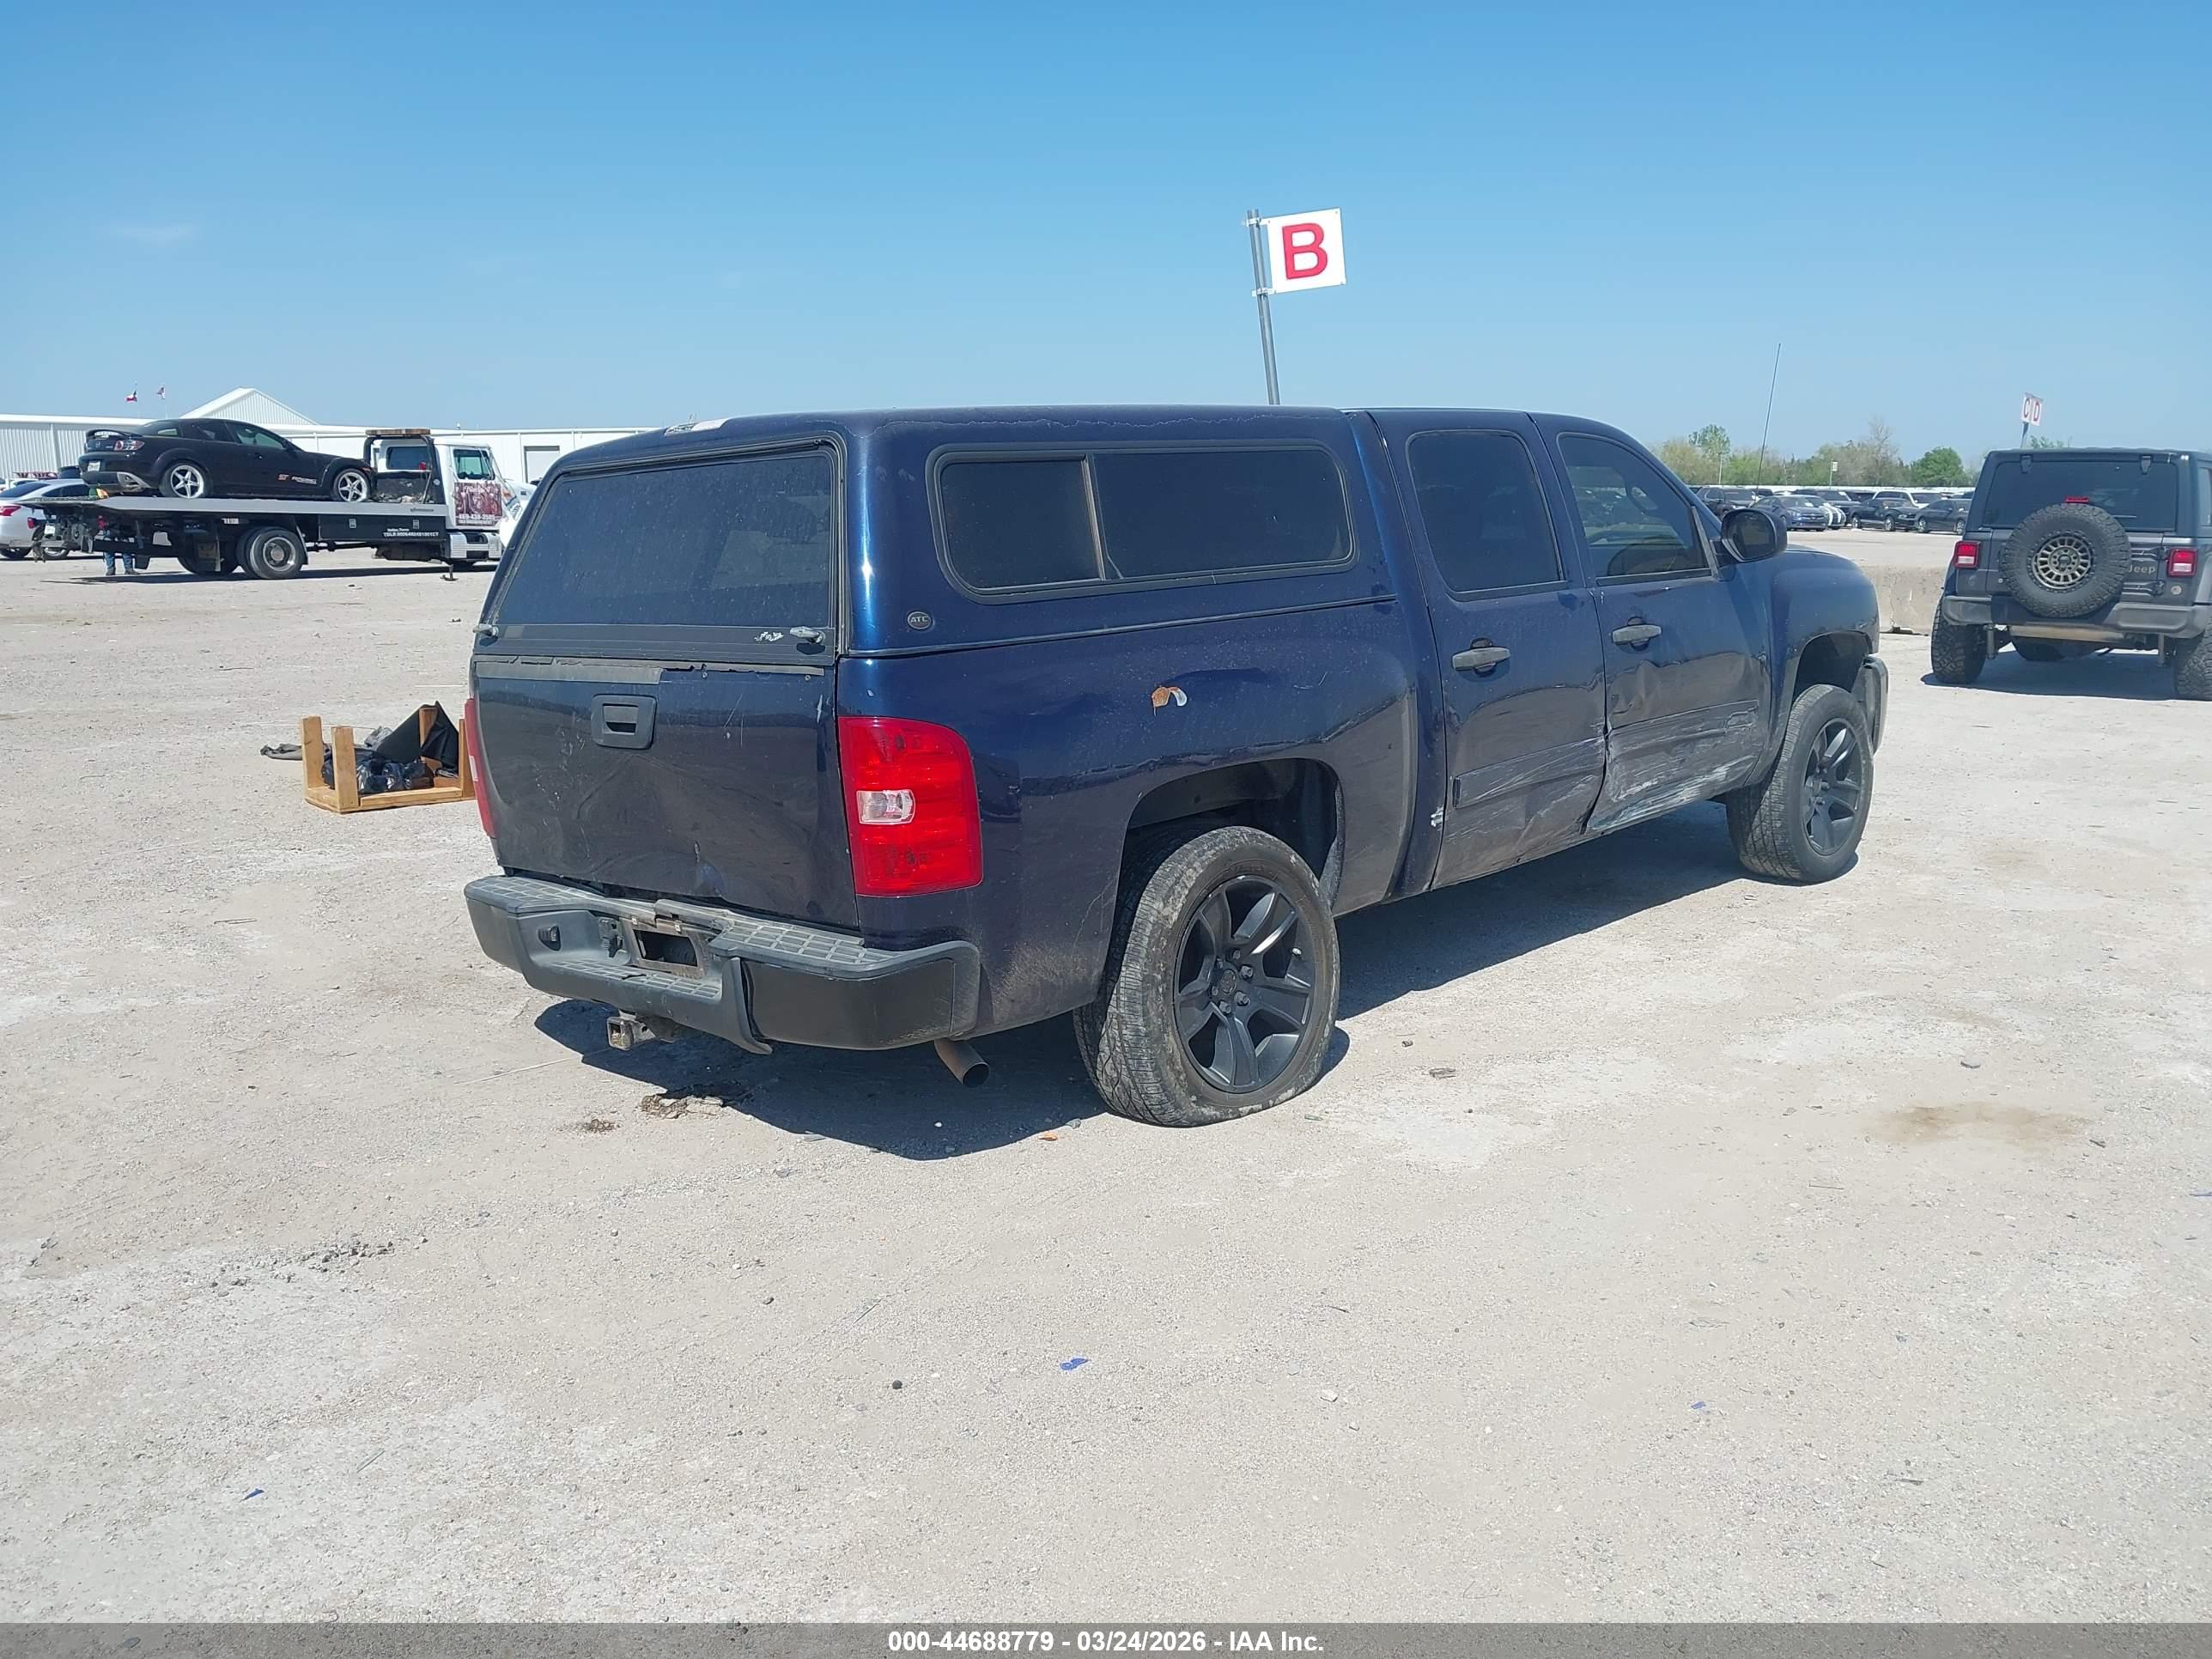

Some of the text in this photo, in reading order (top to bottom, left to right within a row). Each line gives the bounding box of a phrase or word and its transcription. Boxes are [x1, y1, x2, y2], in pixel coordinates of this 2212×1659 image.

[1282, 223, 1328, 280] B
[2024, 398, 2030, 418] C
[2033, 401, 2040, 422] D
[2129, 565, 2156, 574] Jeep
